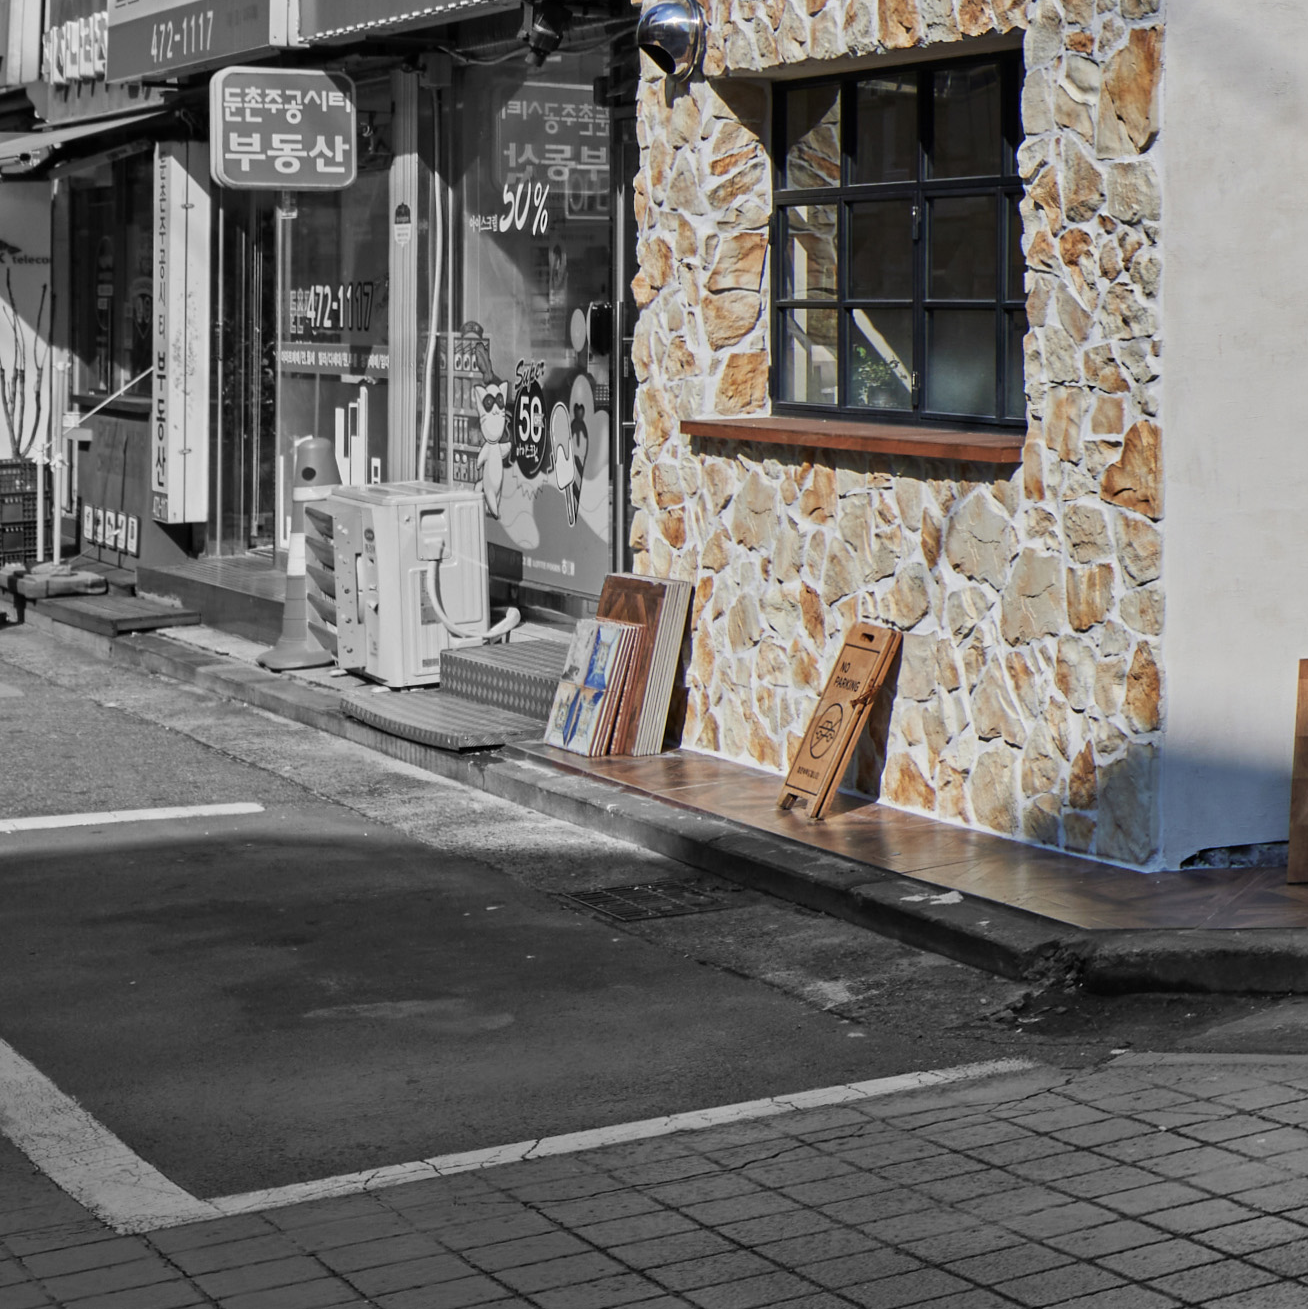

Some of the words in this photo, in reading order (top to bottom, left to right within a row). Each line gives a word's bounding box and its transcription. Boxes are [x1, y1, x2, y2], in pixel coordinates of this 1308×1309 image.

[151, 11, 214, 63] 472-1117
[223, 87, 350, 123] 둔촌주공시티
[225, 133, 349, 174] 부동산
[469, 213, 498, 232] 아이스크림
[499, 182, 550, 235] 50%
[12, 254, 51, 265] teleco
[306, 281, 373, 330] 472-1117
[155, 351, 167, 487] 부동산
[834, 675, 861, 692] PARKING
[841, 661, 851, 674] NO
